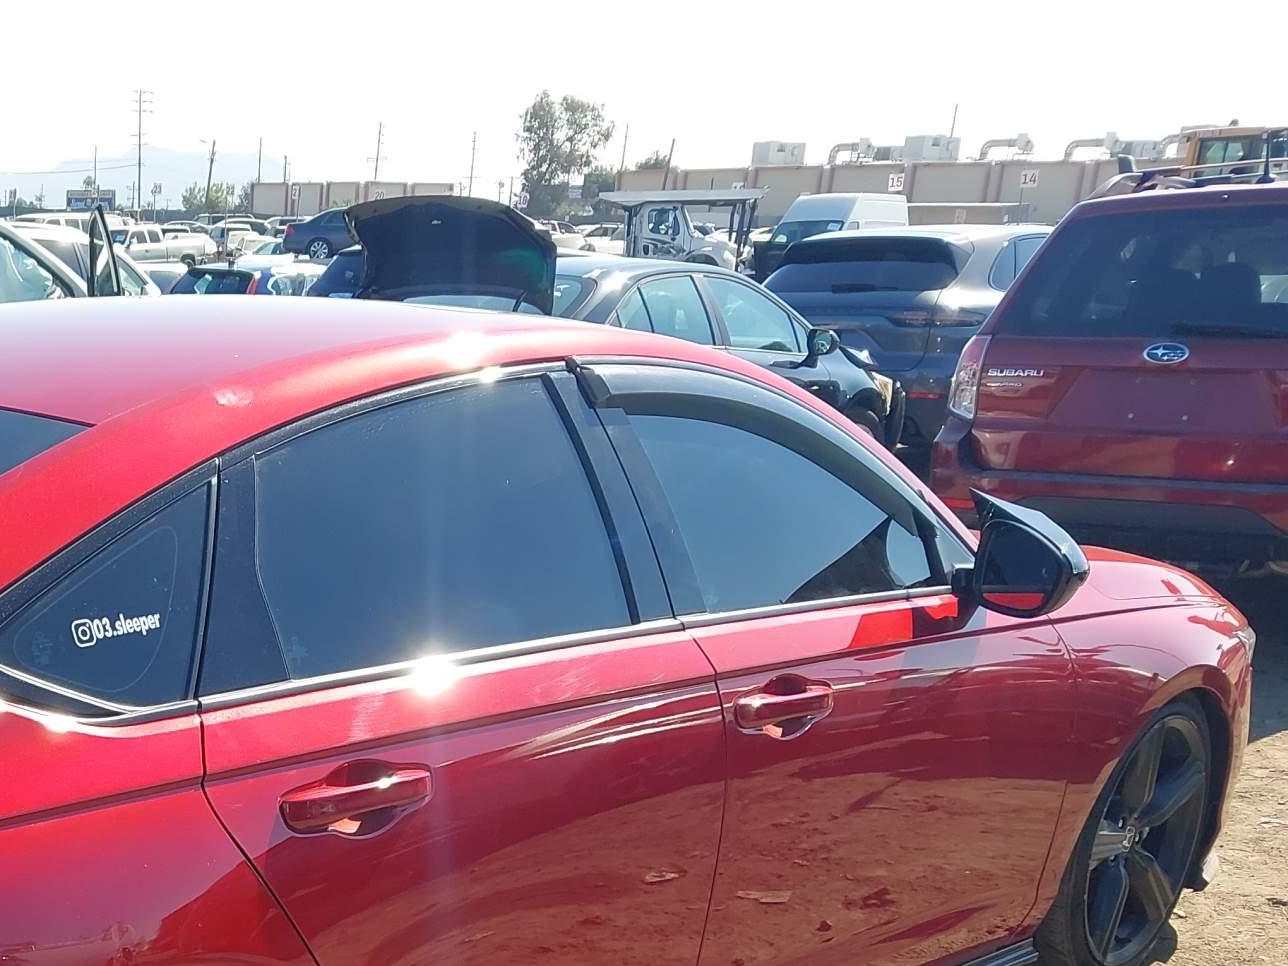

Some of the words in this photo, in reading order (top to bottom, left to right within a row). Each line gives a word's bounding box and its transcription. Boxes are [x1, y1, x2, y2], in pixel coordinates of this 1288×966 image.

[889, 176, 903, 188] 15
[1022, 173, 1037, 185] 14
[375, 191, 385, 200] 20
[988, 368, 1044, 377] SUBARU
[93, 613, 161, 640] 03.sleeper
